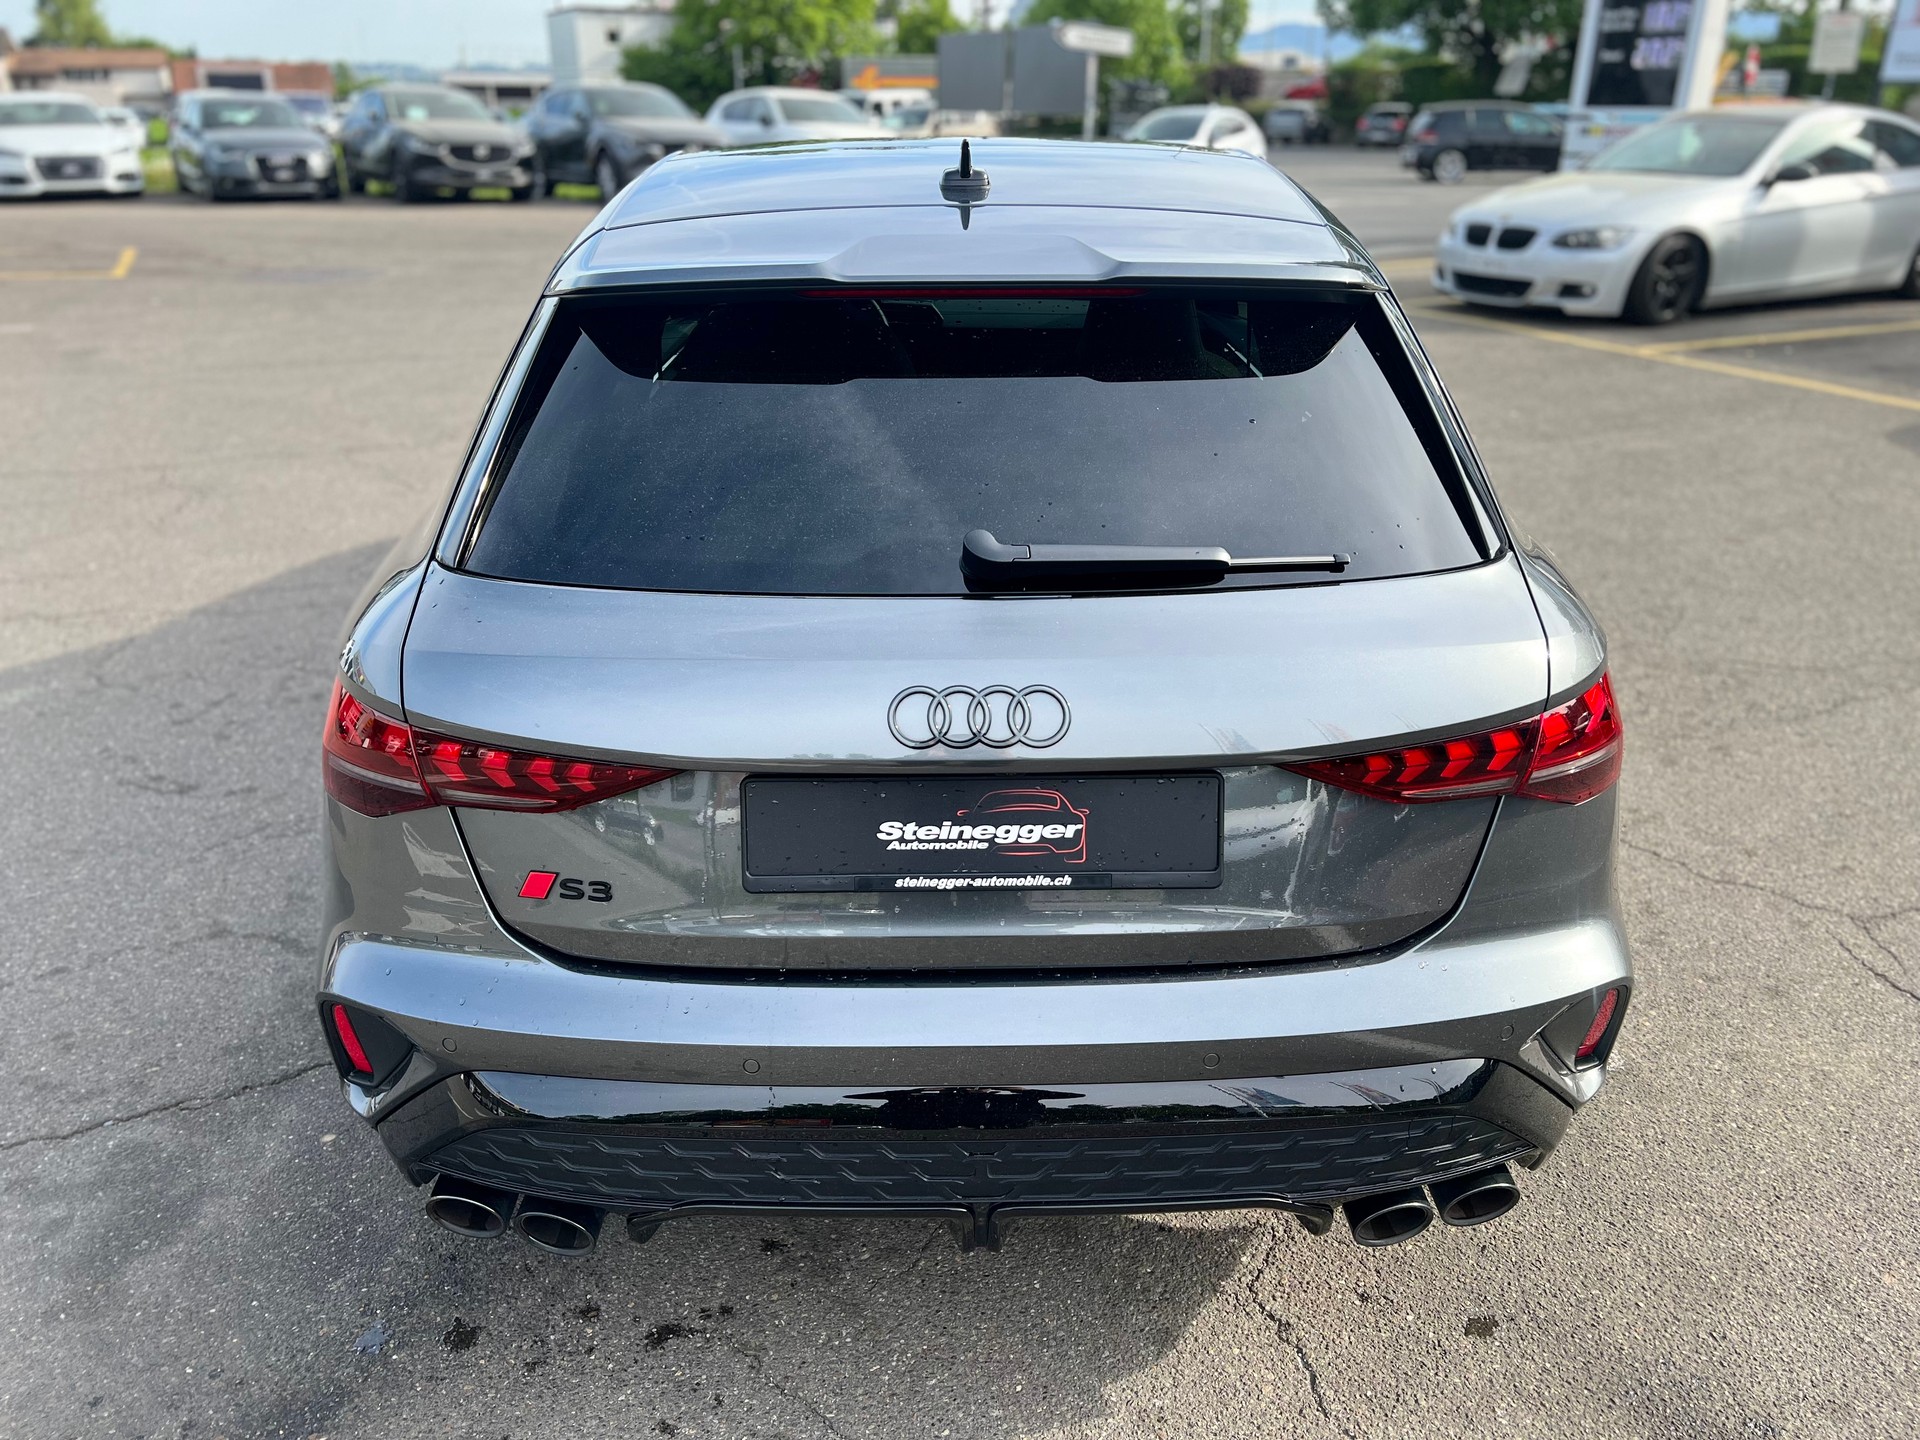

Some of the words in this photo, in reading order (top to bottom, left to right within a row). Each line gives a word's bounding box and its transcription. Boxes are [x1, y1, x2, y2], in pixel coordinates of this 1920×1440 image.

[876, 821, 1083, 843] Steinegger
[886, 840, 989, 850] Automobile
[559, 878, 613, 902] S3
[895, 875, 1072, 889] steinegger-automobile.ch
